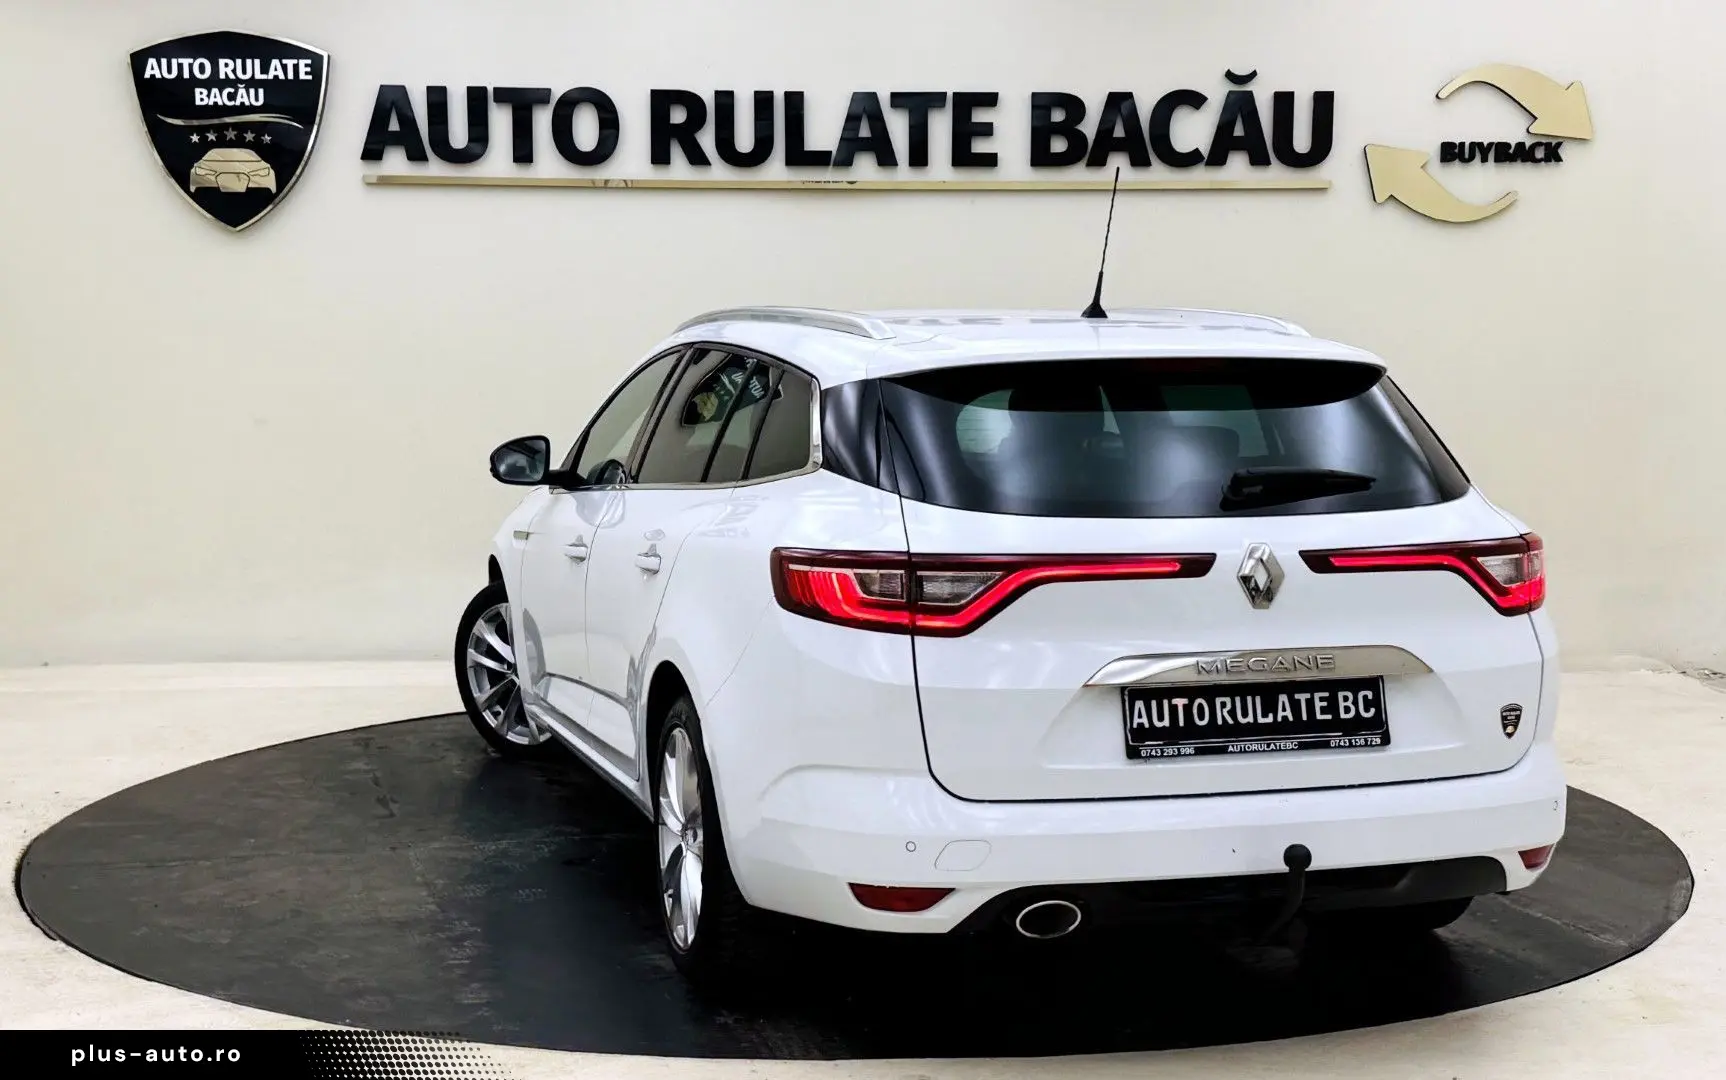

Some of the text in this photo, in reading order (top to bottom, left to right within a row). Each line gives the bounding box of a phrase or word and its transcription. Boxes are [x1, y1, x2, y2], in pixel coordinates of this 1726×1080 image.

[144, 57, 313, 80] AUTO RULATE
[194, 83, 265, 106] BACĂU
[360, 68, 1335, 169] AUTO RULATE BACĂU
[1439, 140, 1564, 164] BUYBACK
[1196, 653, 1336, 675] MEGANE
[1337, 690, 1376, 719] BC
[1140, 748, 1162, 757] 0743
[1227, 741, 1299, 753] AUTORULATEBC
[1330, 739, 1350, 747] 0743
